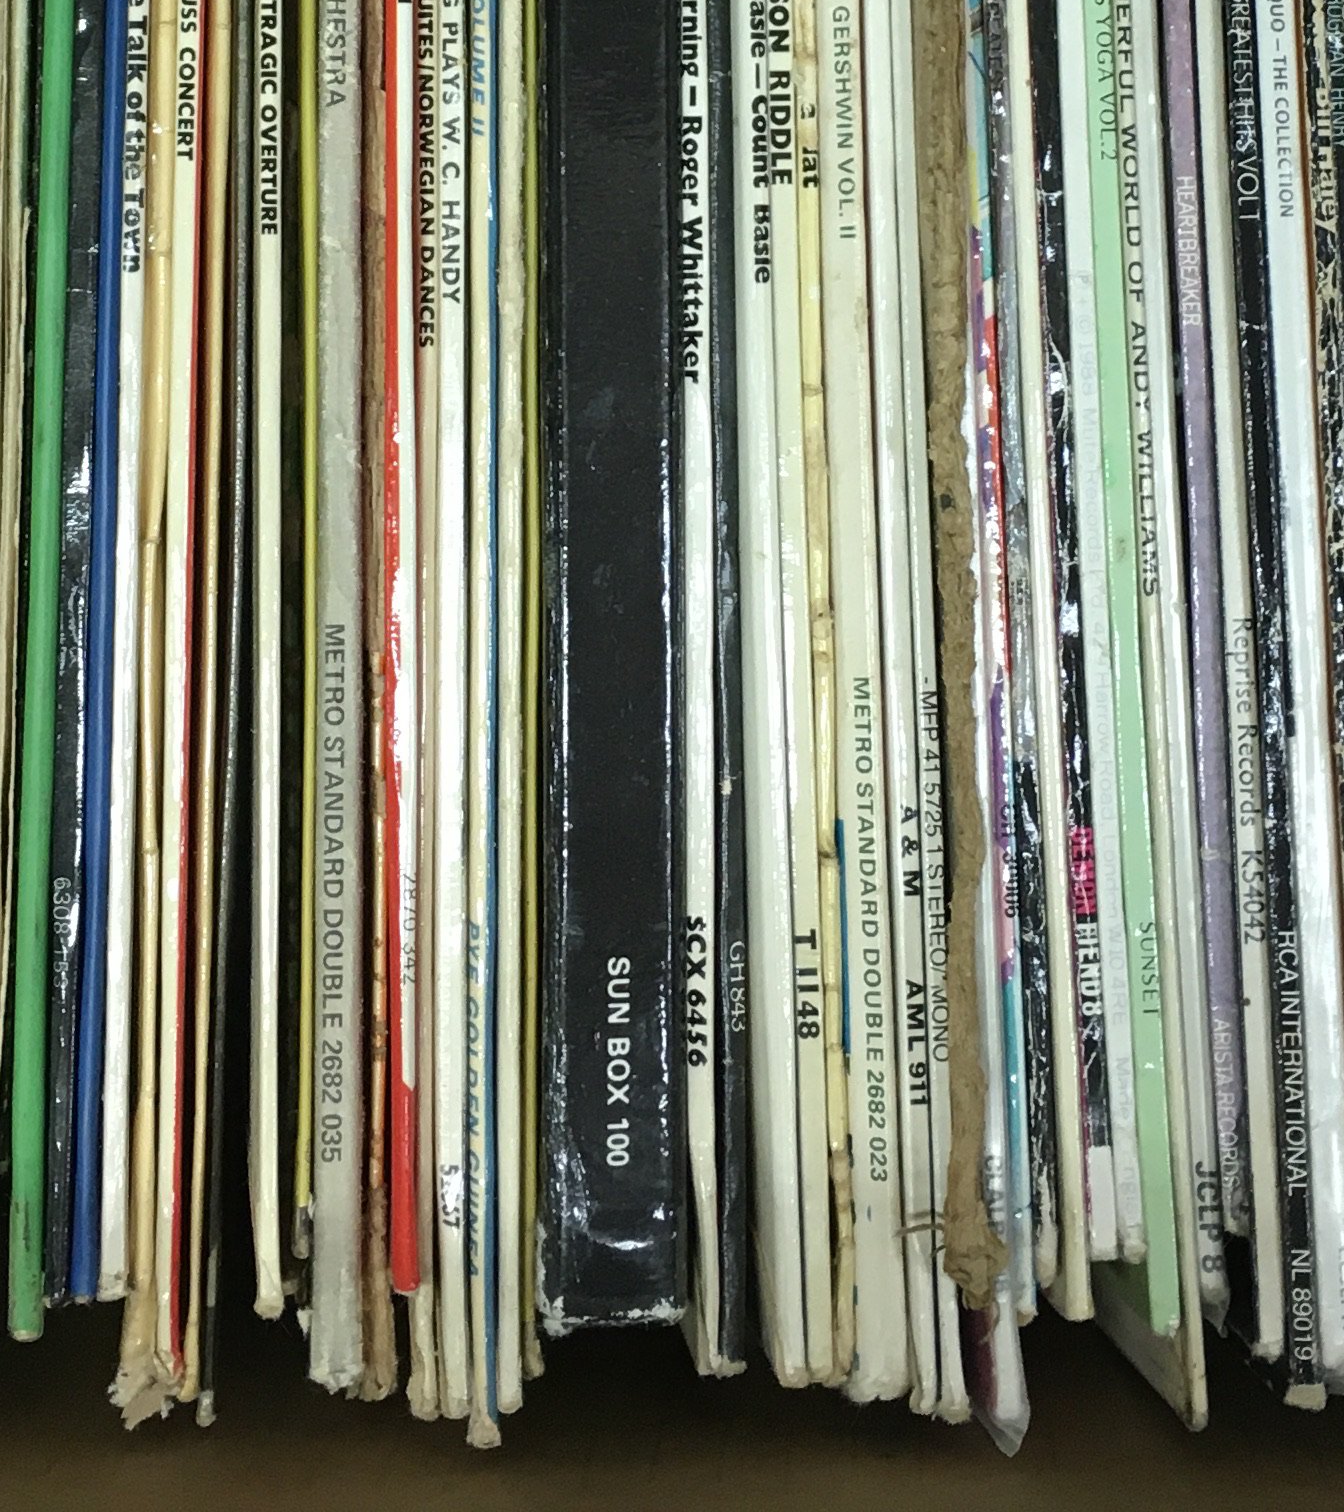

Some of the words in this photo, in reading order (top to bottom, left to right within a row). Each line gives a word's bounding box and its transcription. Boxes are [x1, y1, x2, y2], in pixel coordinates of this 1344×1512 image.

[176, 47, 197, 160] CONCERT
[1272, 55, 1291, 94] THE
[680, 115, 702, 206] Roger
[770, 70, 793, 184] RIDDLE
[1274, 97, 1295, 217] COLLECTION
[260, 104, 278, 235] OVERTURE
[1177, 176, 1201, 326] HEARTBREAKER
[681, 217, 704, 383] Whittaker
[325, 624, 345, 726] METRO
[322, 737, 345, 898] STANDARD
[322, 909, 344, 1029] DOUBLE
[686, 917, 704, 977] SCX
[1277, 930, 1301, 983] RCA
[607, 956, 630, 1024] SUN
[688, 989, 707, 1067] 6456
[322, 1040, 343, 1104] 2682
[607, 1037, 629, 1106] BOX
[1280, 989, 1309, 1196] INTERNATIONAL
[321, 1114, 343, 1163] 035
[606, 1118, 630, 1166] 100
[1292, 1249, 1312, 1281] NL
[1292, 1287, 1314, 1359] 89019
